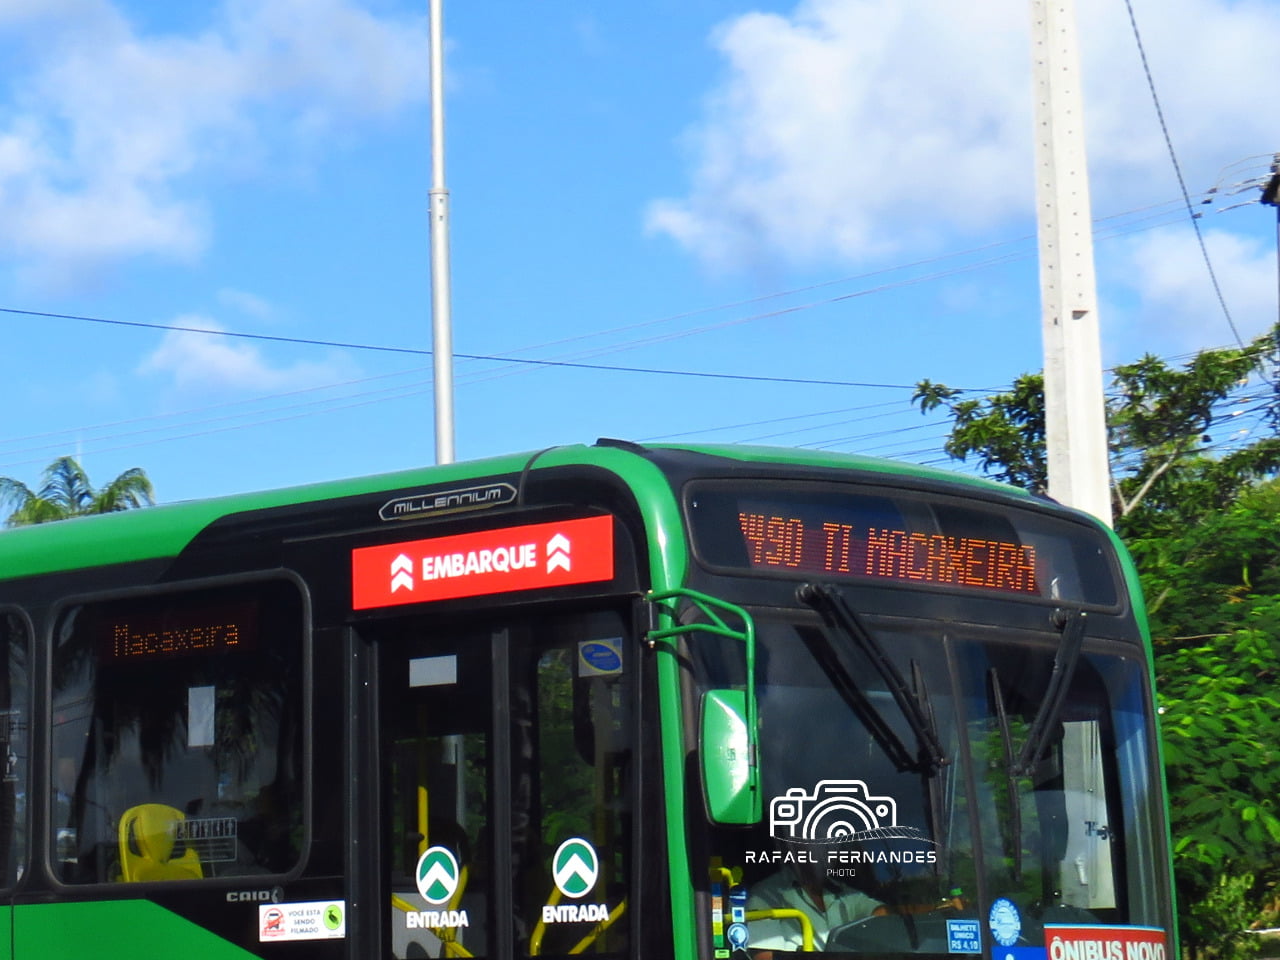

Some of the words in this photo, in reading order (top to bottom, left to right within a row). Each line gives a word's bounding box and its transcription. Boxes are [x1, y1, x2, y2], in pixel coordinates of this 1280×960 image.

[393, 488, 501, 514] MILLENNIUM
[422, 543, 537, 581] EMBARQUE
[823, 522, 853, 572] TI
[866, 527, 1036, 591] MACAXEIRA
[115, 624, 238, 657] Macaxeira
[226, 890, 270, 902] CAIO
[406, 910, 469, 929] ENTRADA
[542, 904, 610, 923] ENTRADA
